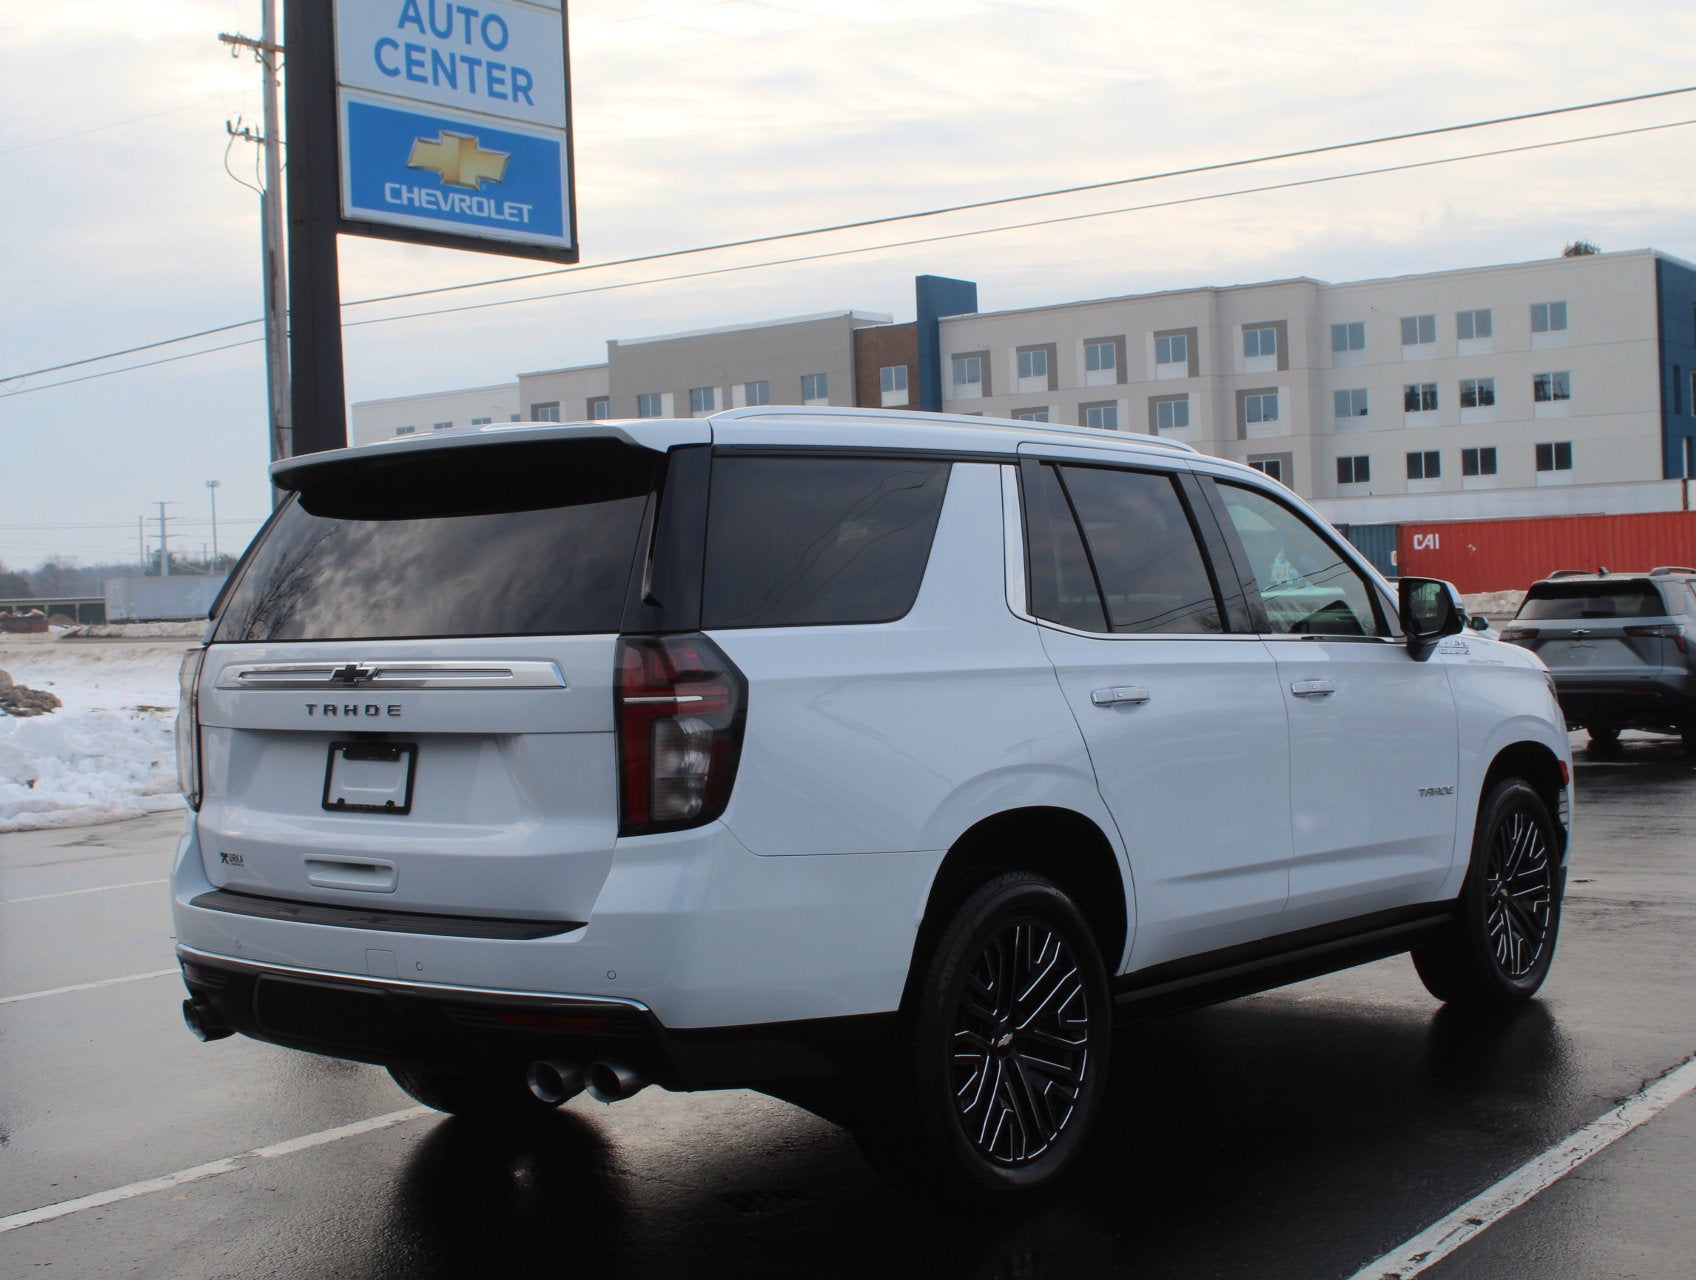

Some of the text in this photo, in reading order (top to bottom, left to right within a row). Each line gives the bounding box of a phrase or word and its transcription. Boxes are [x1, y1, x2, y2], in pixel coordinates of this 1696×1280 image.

[397, 0, 509, 51] AUTO
[374, 37, 535, 106] CENTER
[384, 182, 533, 223] CHEVROLET
[1413, 533, 1439, 550] CAI
[305, 704, 402, 716] TAHOE
